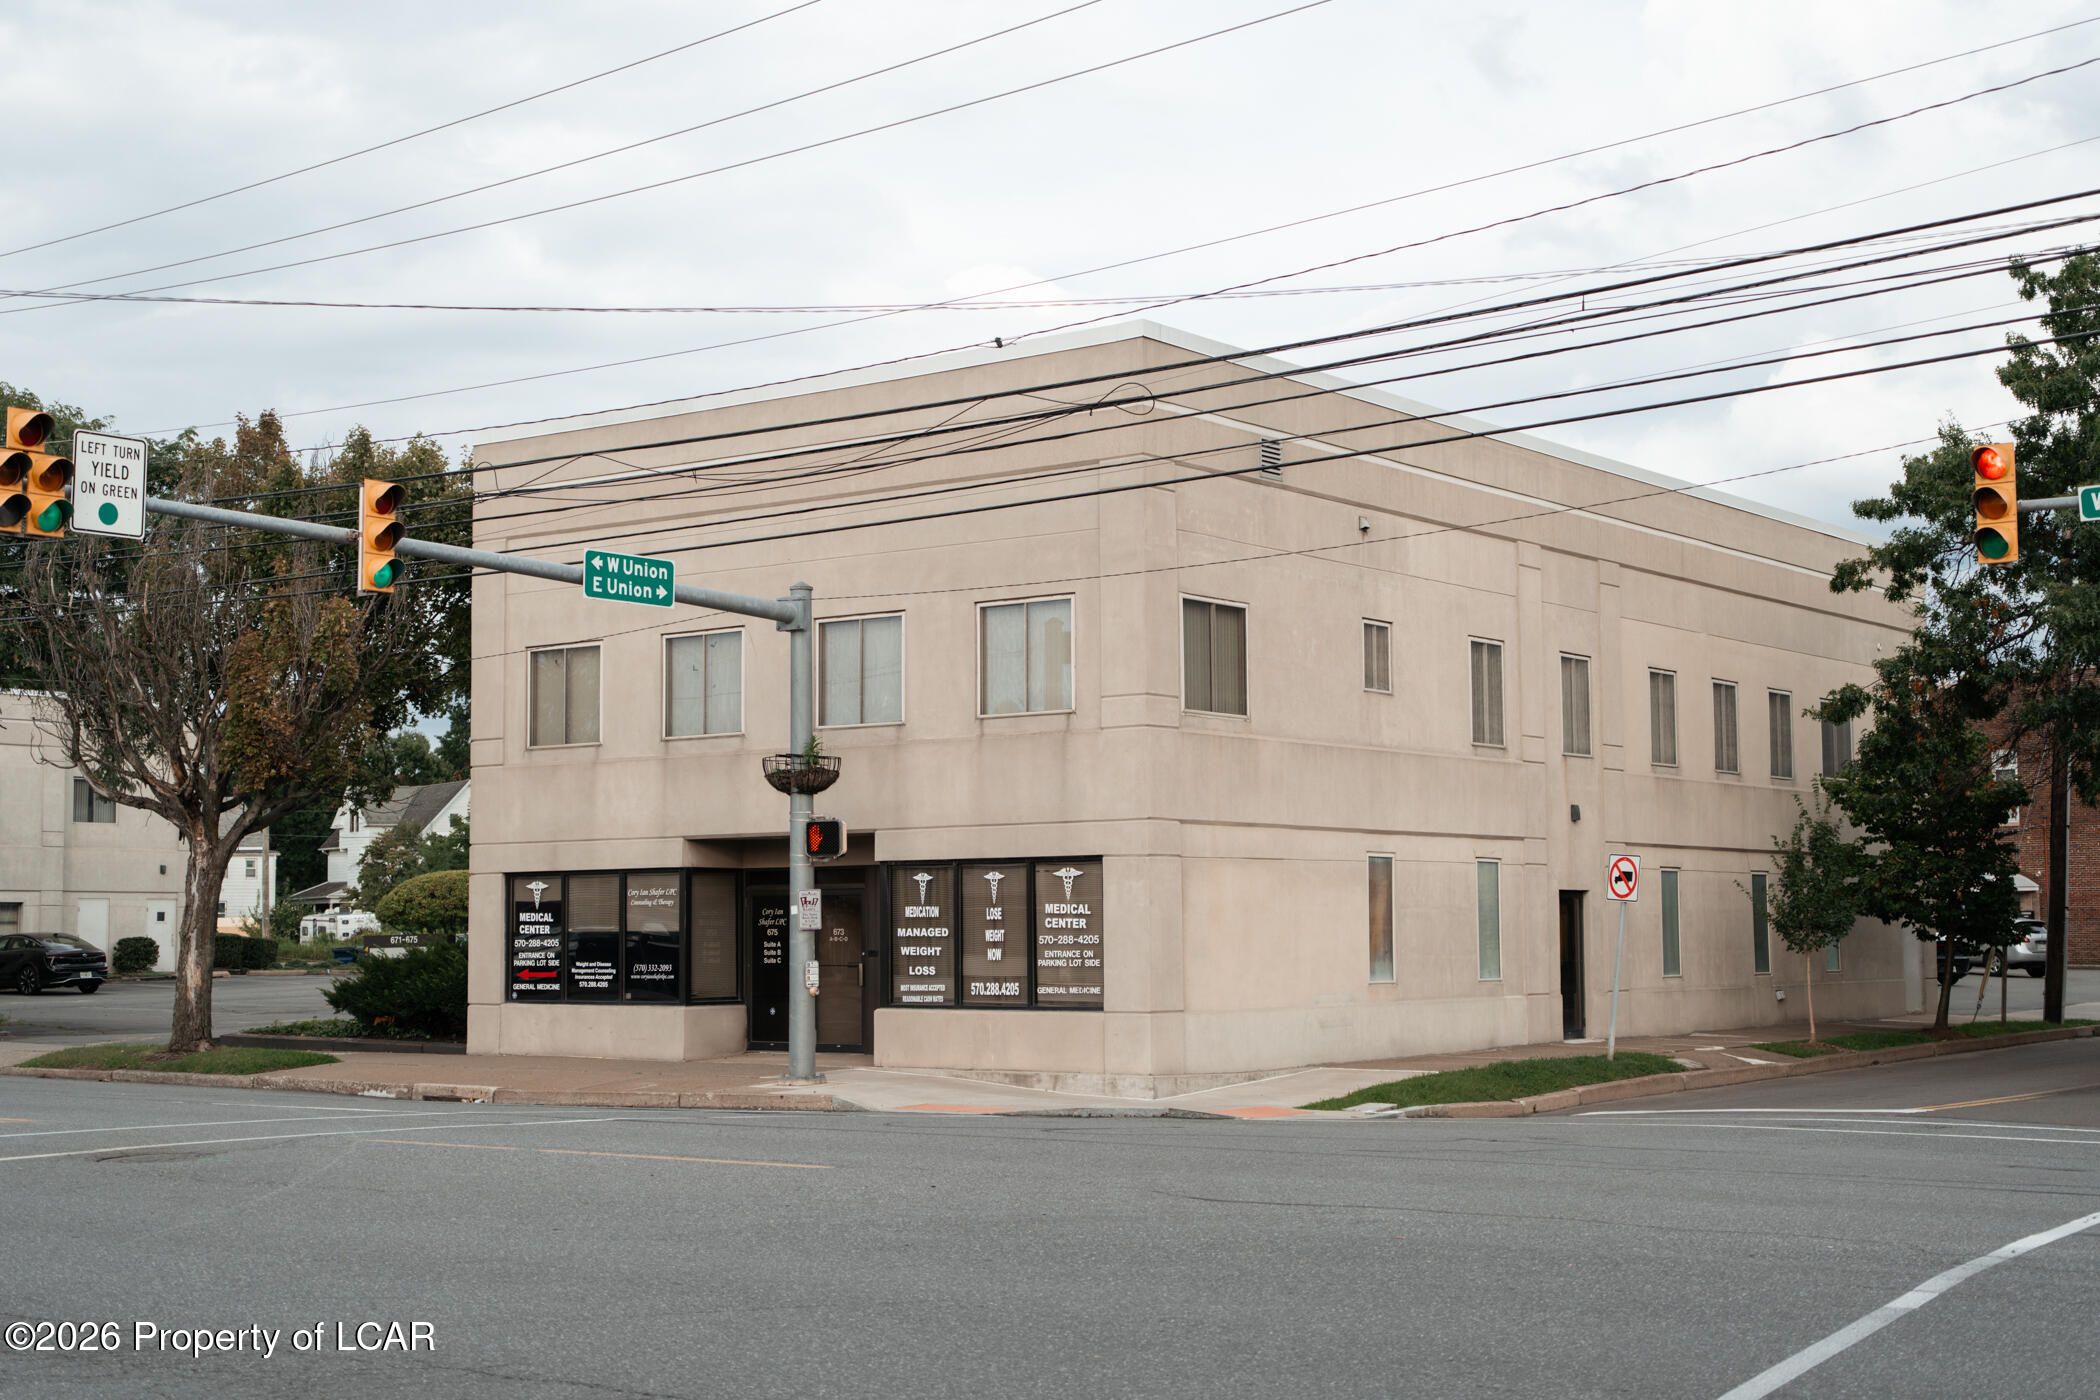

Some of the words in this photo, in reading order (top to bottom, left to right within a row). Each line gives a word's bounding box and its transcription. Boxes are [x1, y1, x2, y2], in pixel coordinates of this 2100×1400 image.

[81, 440, 106, 455] LEFT
[113, 445, 140, 460] TURN
[92, 460, 129, 480] YIELD
[81, 481, 95, 494] ON
[102, 483, 138, 499] GREEN
[607, 556, 619, 573] W
[623, 558, 668, 580] Union
[593, 576, 602, 592] E
[607, 578, 652, 598] Union
[905, 906, 939, 918] MEDICATION
[986, 907, 1002, 920] LOSE
[1045, 903, 1091, 914] MEDICAL
[519, 912, 554, 922] MEDICAL
[1045, 918, 1087, 929] CENTER
[519, 925, 550, 935] CENTER
[833, 928, 845, 936] 673
[897, 928, 949, 937] MANAGED
[390, 935, 418, 944] 671-675
[985, 929, 1005, 942] WEIGHT
[1038, 935, 1099, 944] 570-288-4205
[514, 939, 560, 948] 570-288-4205
[900, 947, 942, 956] WEIGHT
[987, 948, 1002, 961] NOW
[1044, 950, 1081, 958] ENTRANCE
[1083, 950, 1094, 958] ON
[513, 959, 536, 967] PARKING
[536, 959, 547, 967] LOT
[548, 959, 560, 967] SIDE
[633, 963, 648, 974] (570)
[909, 966, 936, 975] LOSS
[513, 983, 536, 991] GENERAL
[536, 983, 560, 991] MEDICINE
[971, 982, 1020, 996] 570.288.4205
[1069, 986, 1101, 994] MEDICINE
